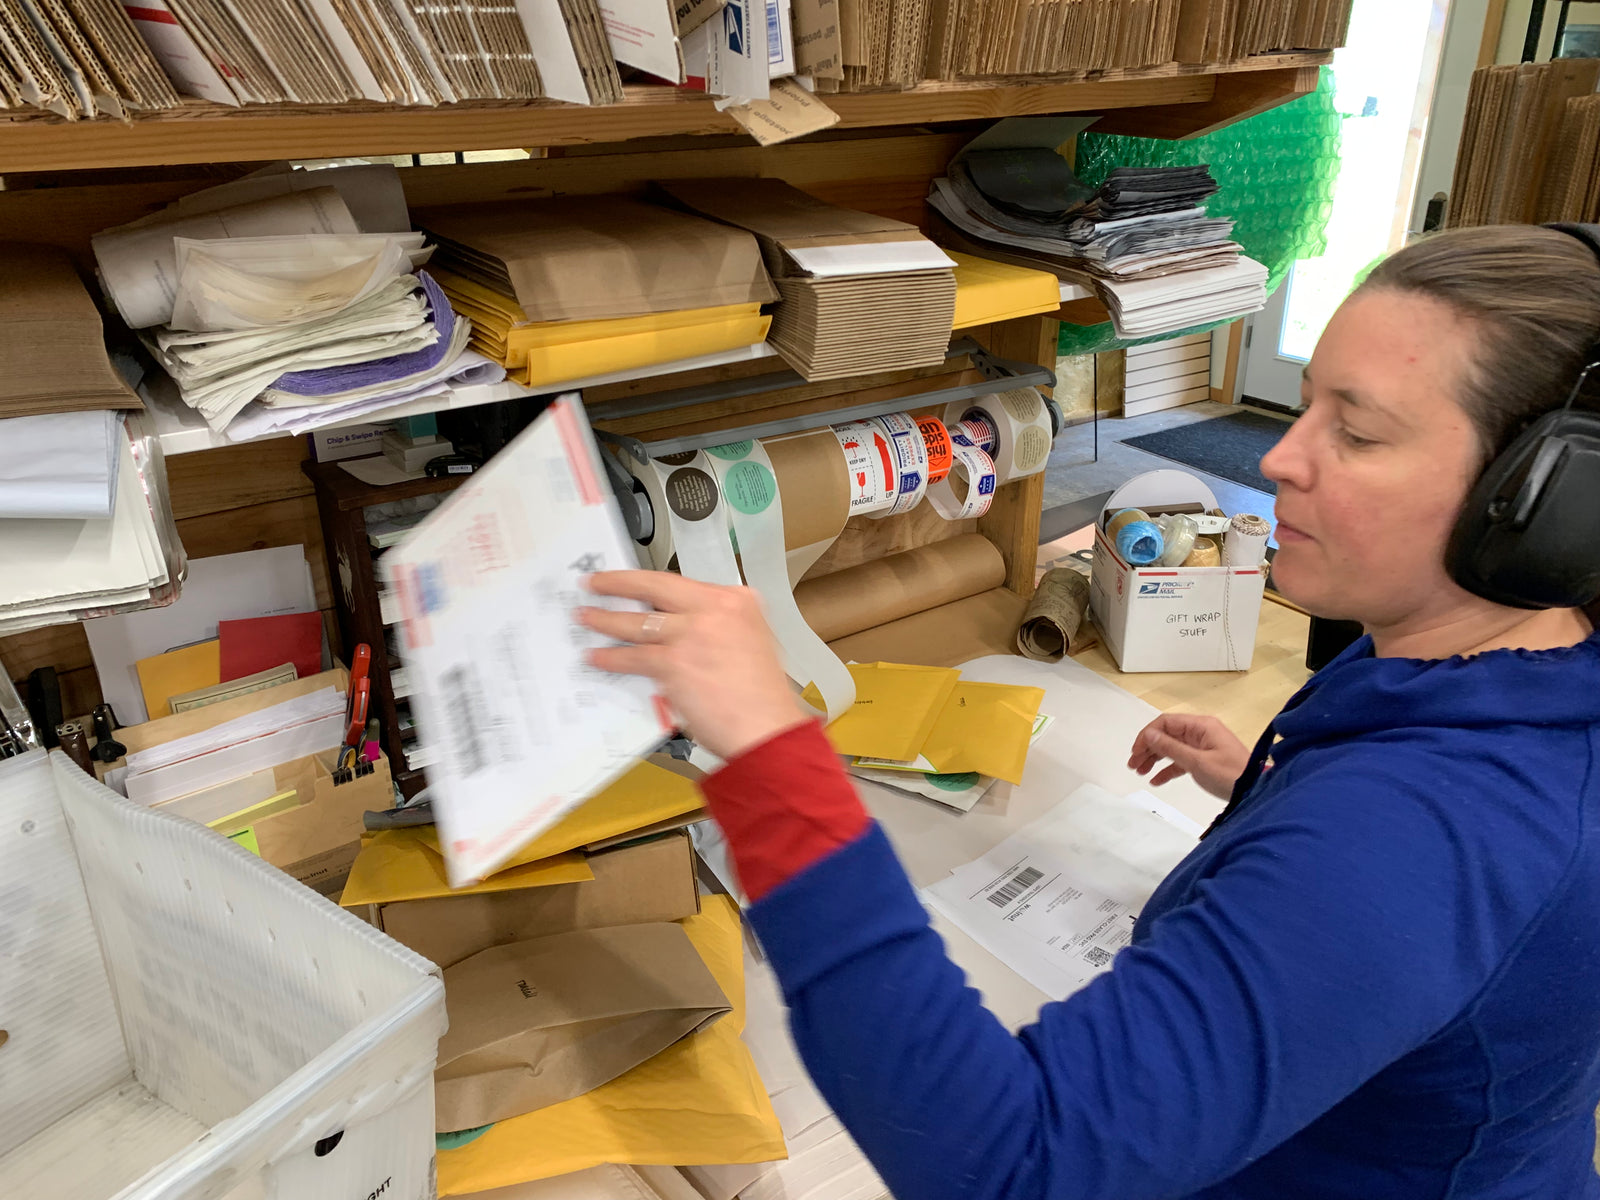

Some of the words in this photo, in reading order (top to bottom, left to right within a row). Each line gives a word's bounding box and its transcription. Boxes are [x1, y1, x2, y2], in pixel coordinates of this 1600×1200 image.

[327, 435, 344, 446] Chip
[351, 431, 373, 441] Swipe
[923, 432, 944, 445] side
[927, 444, 946, 457] this
[851, 496, 873, 506] FRAGILE
[885, 491, 893, 499] UP
[1166, 614, 1188, 624] GIFT
[1193, 612, 1221, 623] WRAP
[1179, 628, 1208, 637] STUFF
